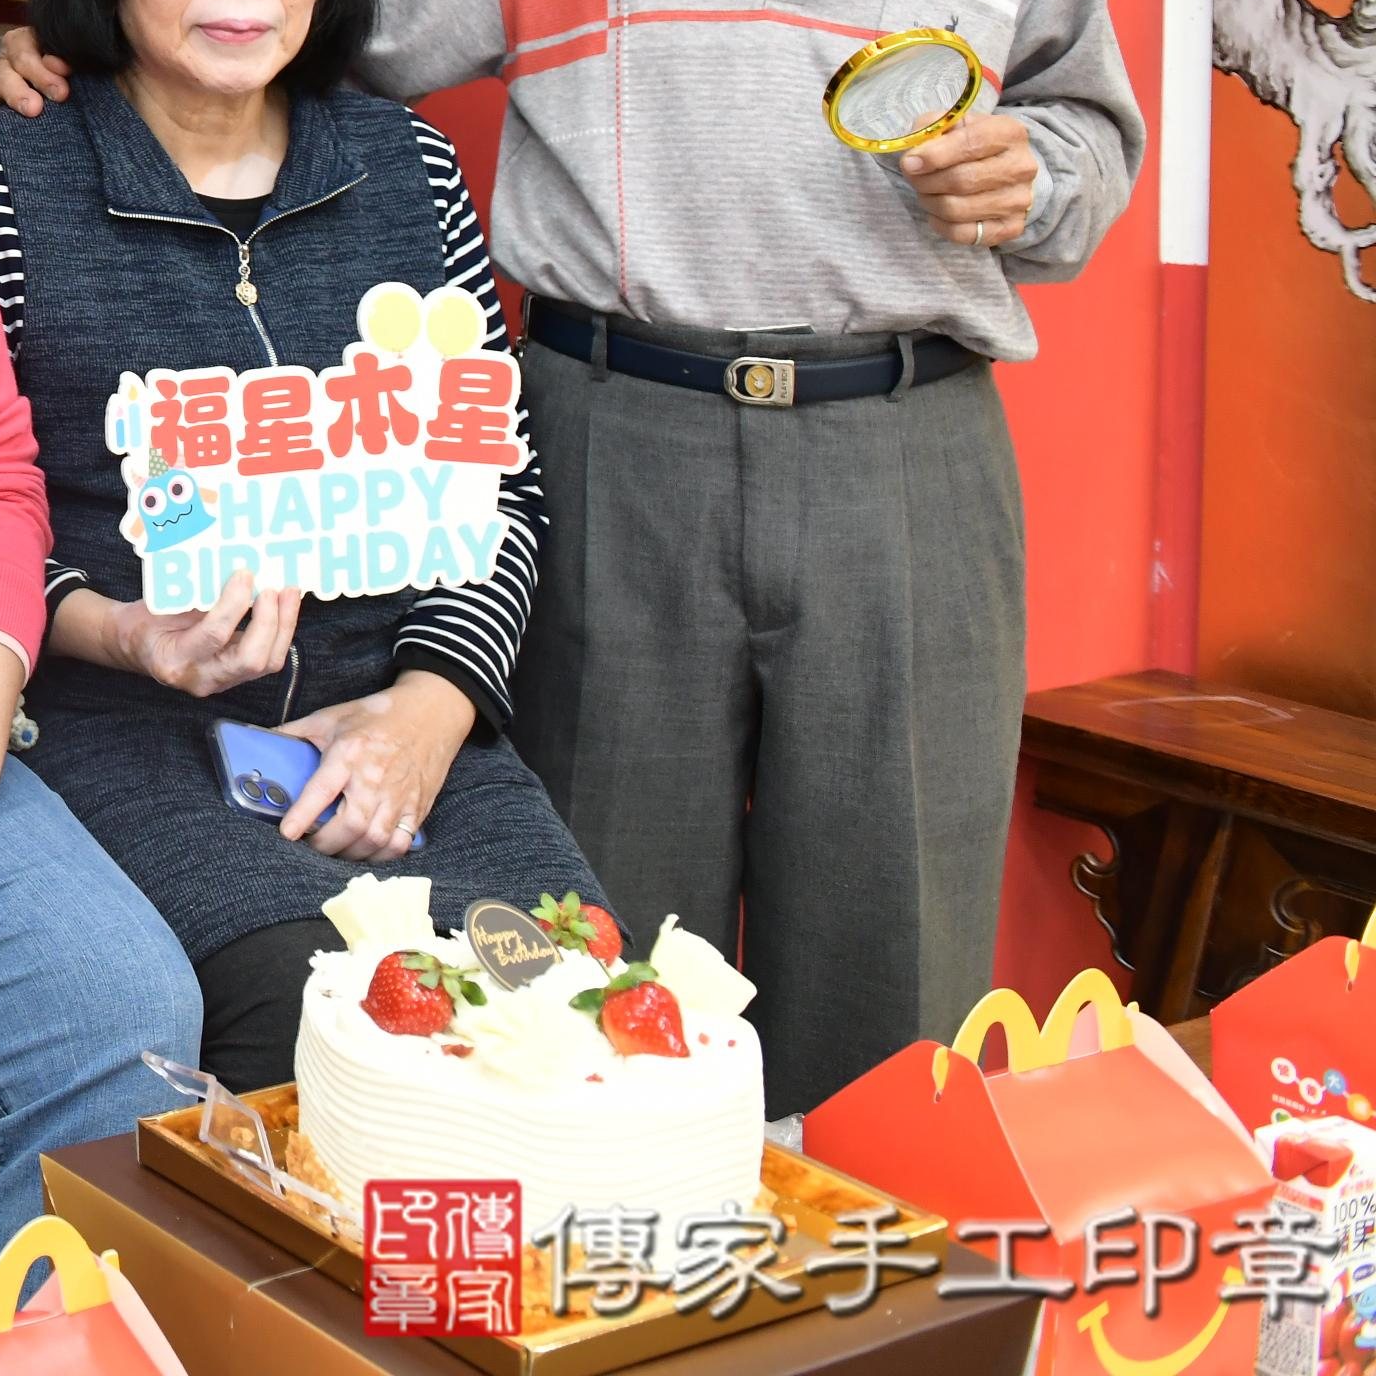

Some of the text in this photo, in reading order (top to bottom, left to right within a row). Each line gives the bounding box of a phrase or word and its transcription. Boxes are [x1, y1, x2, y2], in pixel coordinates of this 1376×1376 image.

[150, 352, 520, 476] 福星本星
[219, 464, 454, 541] HAPPY
[152, 521, 501, 610] BIRTHDAY
[473, 925, 520, 949] Happy
[493, 941, 562, 966] Birthday
[1333, 1193, 1376, 1226] 100%
